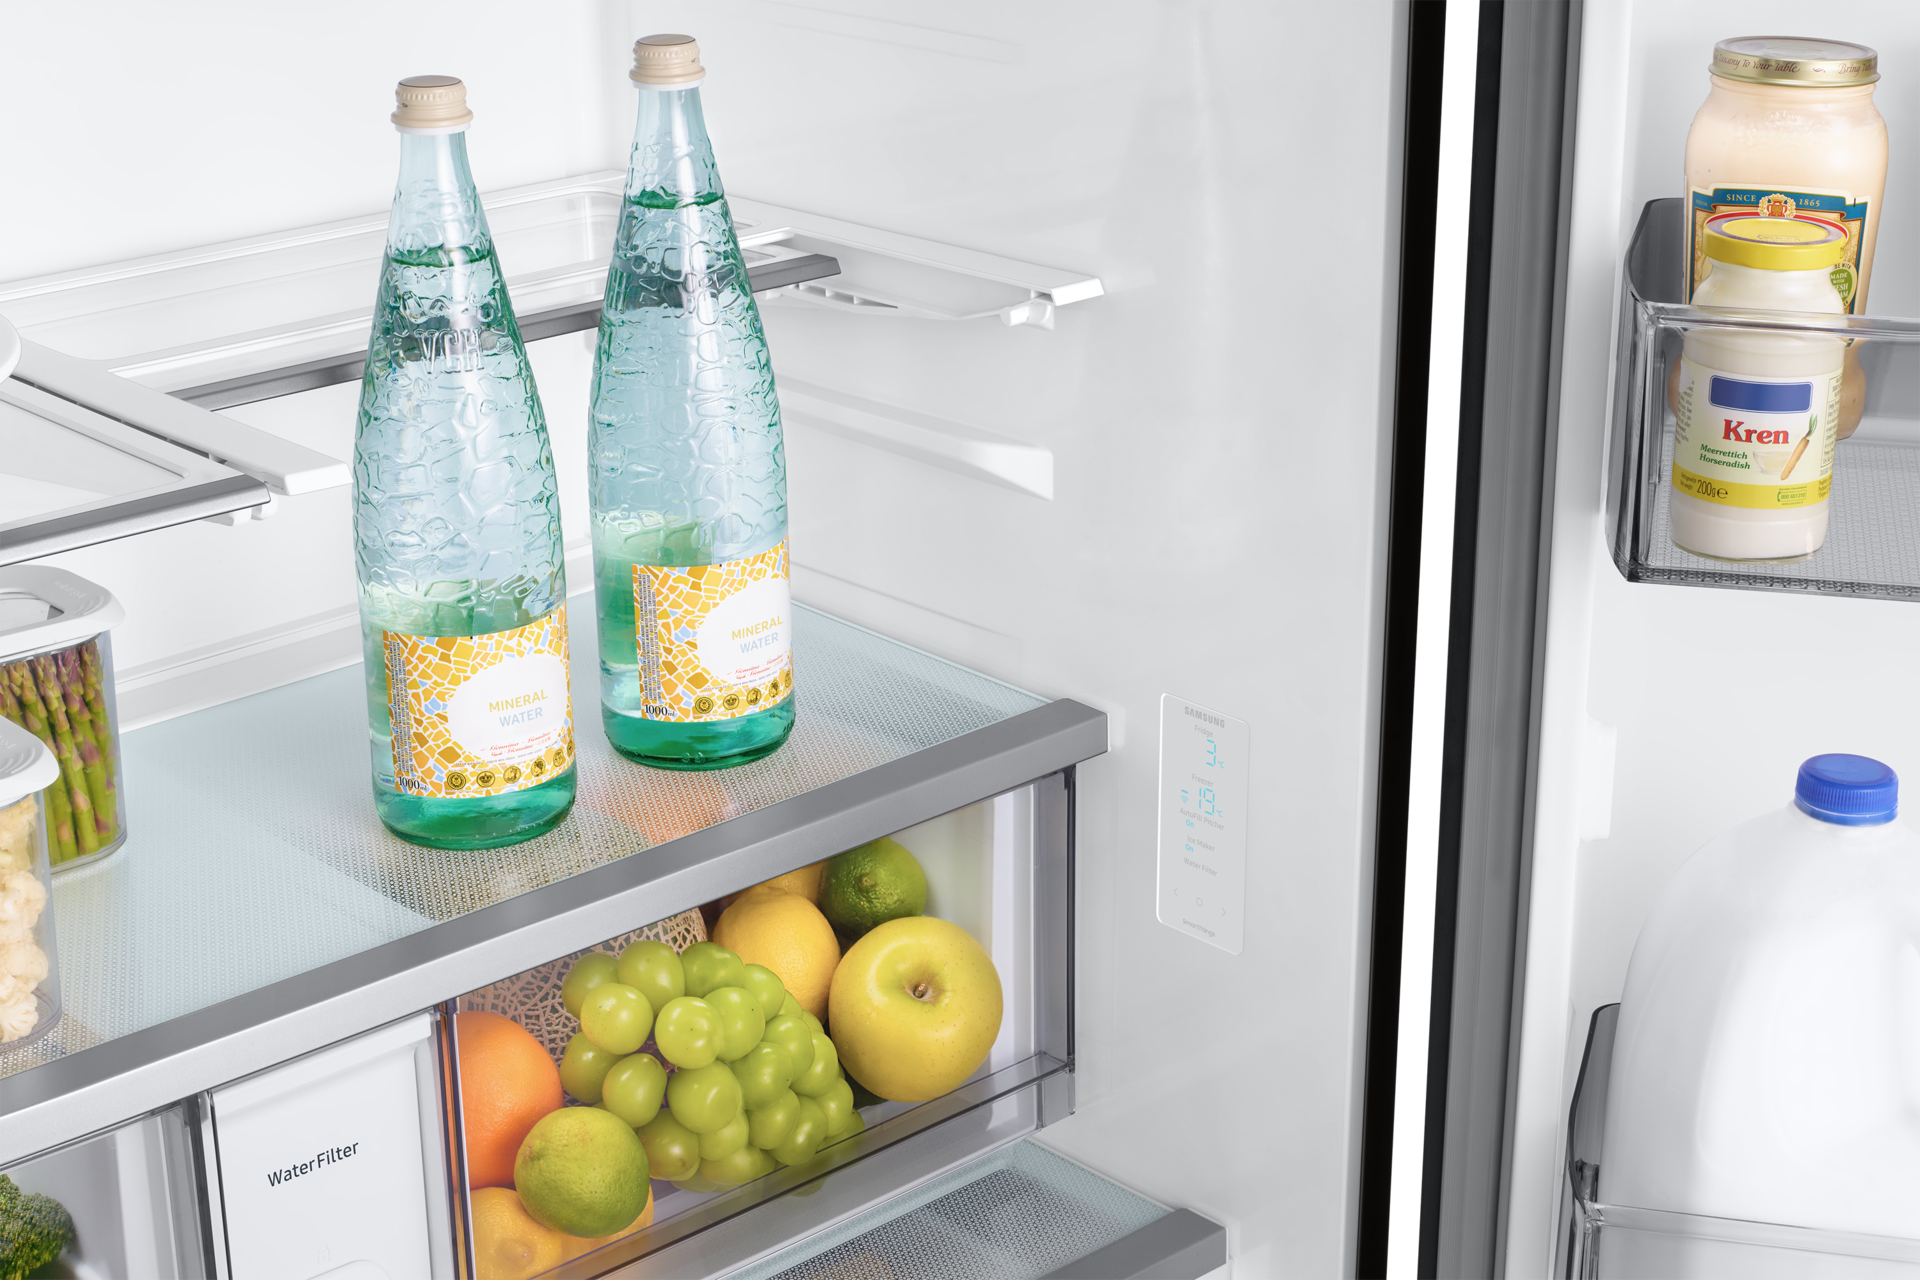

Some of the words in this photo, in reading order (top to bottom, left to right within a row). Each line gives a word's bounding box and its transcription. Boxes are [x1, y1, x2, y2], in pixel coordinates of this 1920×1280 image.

[1742, 58, 1750, 68] To
[1752, 60, 1772, 71] Your
[1774, 62, 1800, 73] Table
[1838, 63, 1861, 78] Bring
[1726, 193, 1757, 203] SINCE
[1799, 198, 1820, 208] 1865
[1722, 418, 1790, 445] Kren
[1700, 443, 1748, 460] Meerrettich
[1699, 453, 1751, 470] Horseradish
[731, 614, 784, 641] MINERAL
[740, 632, 779, 654] WATER
[488, 689, 548, 713] MINERAL
[498, 706, 543, 728] WATER
[1184, 706, 1226, 728] SAMSUNG
[1194, 724, 1214, 738] Fridge
[1205, 738, 1217, 768] 3
[1192, 773, 1214, 788] Freezer
[1179, 807, 1203, 824] AutoFill
[1203, 815, 1225, 831] Pitcher
[1185, 818, 1195, 829] On
[1184, 844, 1194, 853] On
[1187, 835, 1195, 846] Ice
[1196, 838, 1216, 852] Maker
[1183, 857, 1201, 871] Water
[1201, 862, 1218, 877] Filter
[1182, 918, 1216, 938] SmartThings
